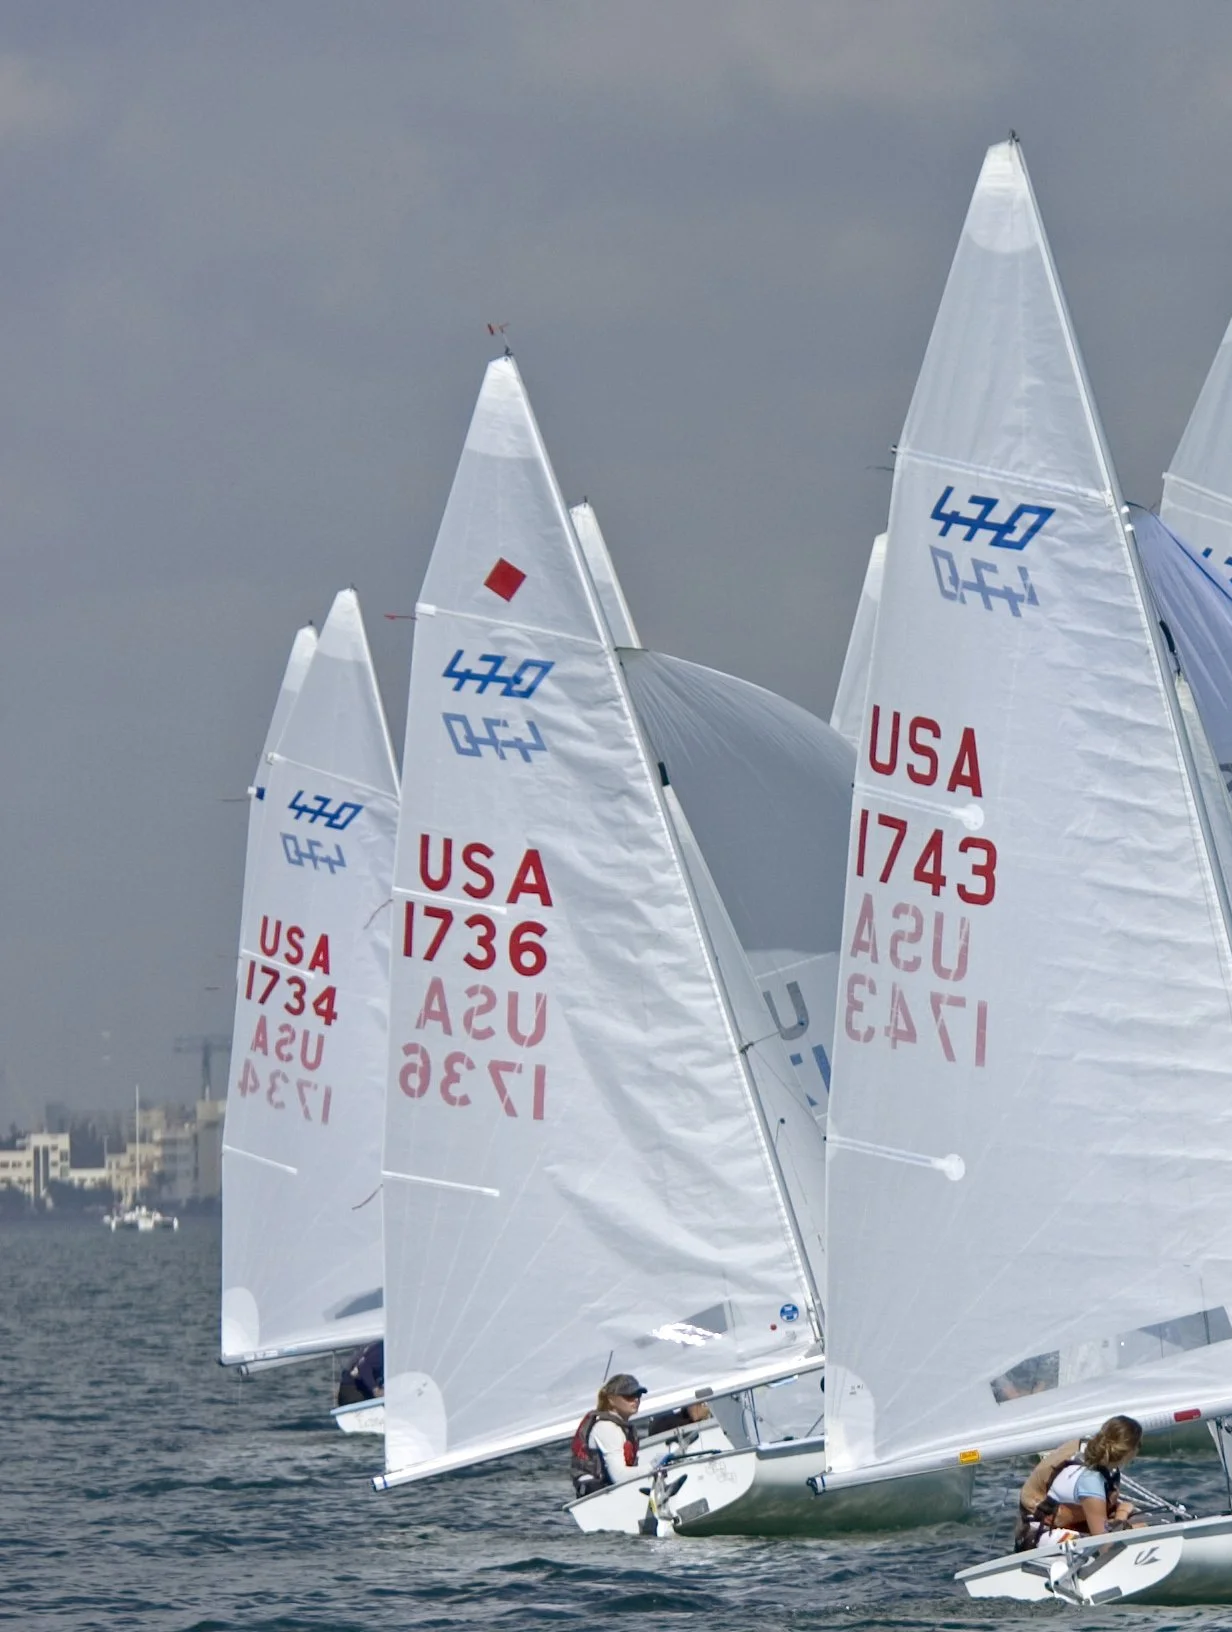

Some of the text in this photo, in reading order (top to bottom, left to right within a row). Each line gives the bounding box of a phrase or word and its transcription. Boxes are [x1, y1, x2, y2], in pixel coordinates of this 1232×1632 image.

[930, 486, 1056, 551] 470
[441, 649, 555, 699] 470
[868, 704, 983, 798] USA
[287, 788, 363, 830] 470
[418, 834, 553, 907] USA
[856, 809, 998, 906] 1743
[259, 915, 330, 975] USA
[402, 901, 548, 977] 1736
[244, 960, 338, 1026] 1734
